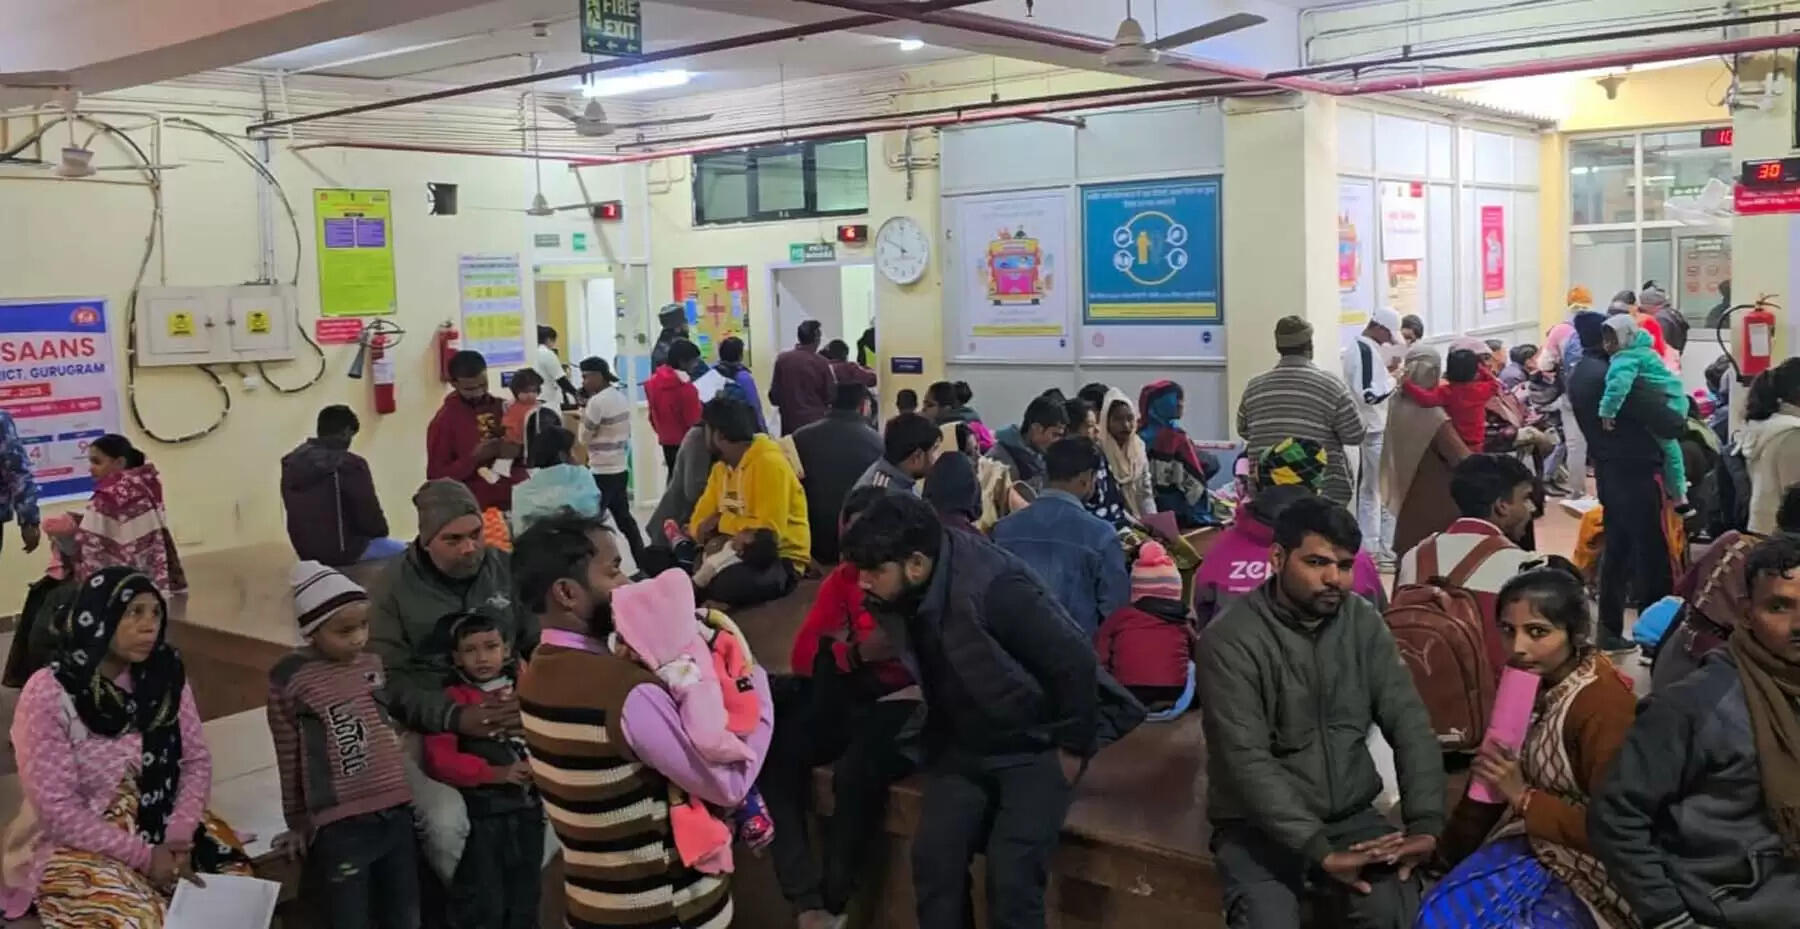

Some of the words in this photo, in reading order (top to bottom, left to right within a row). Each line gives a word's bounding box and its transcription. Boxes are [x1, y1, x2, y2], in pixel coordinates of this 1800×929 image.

[603, 0, 636, 17] FIRE
[603, 19, 636, 40] EXIT
[1757, 164, 1782, 179] 30
[30, 363, 105, 378] GURUGRAM
[30, 446, 41, 459] 4
